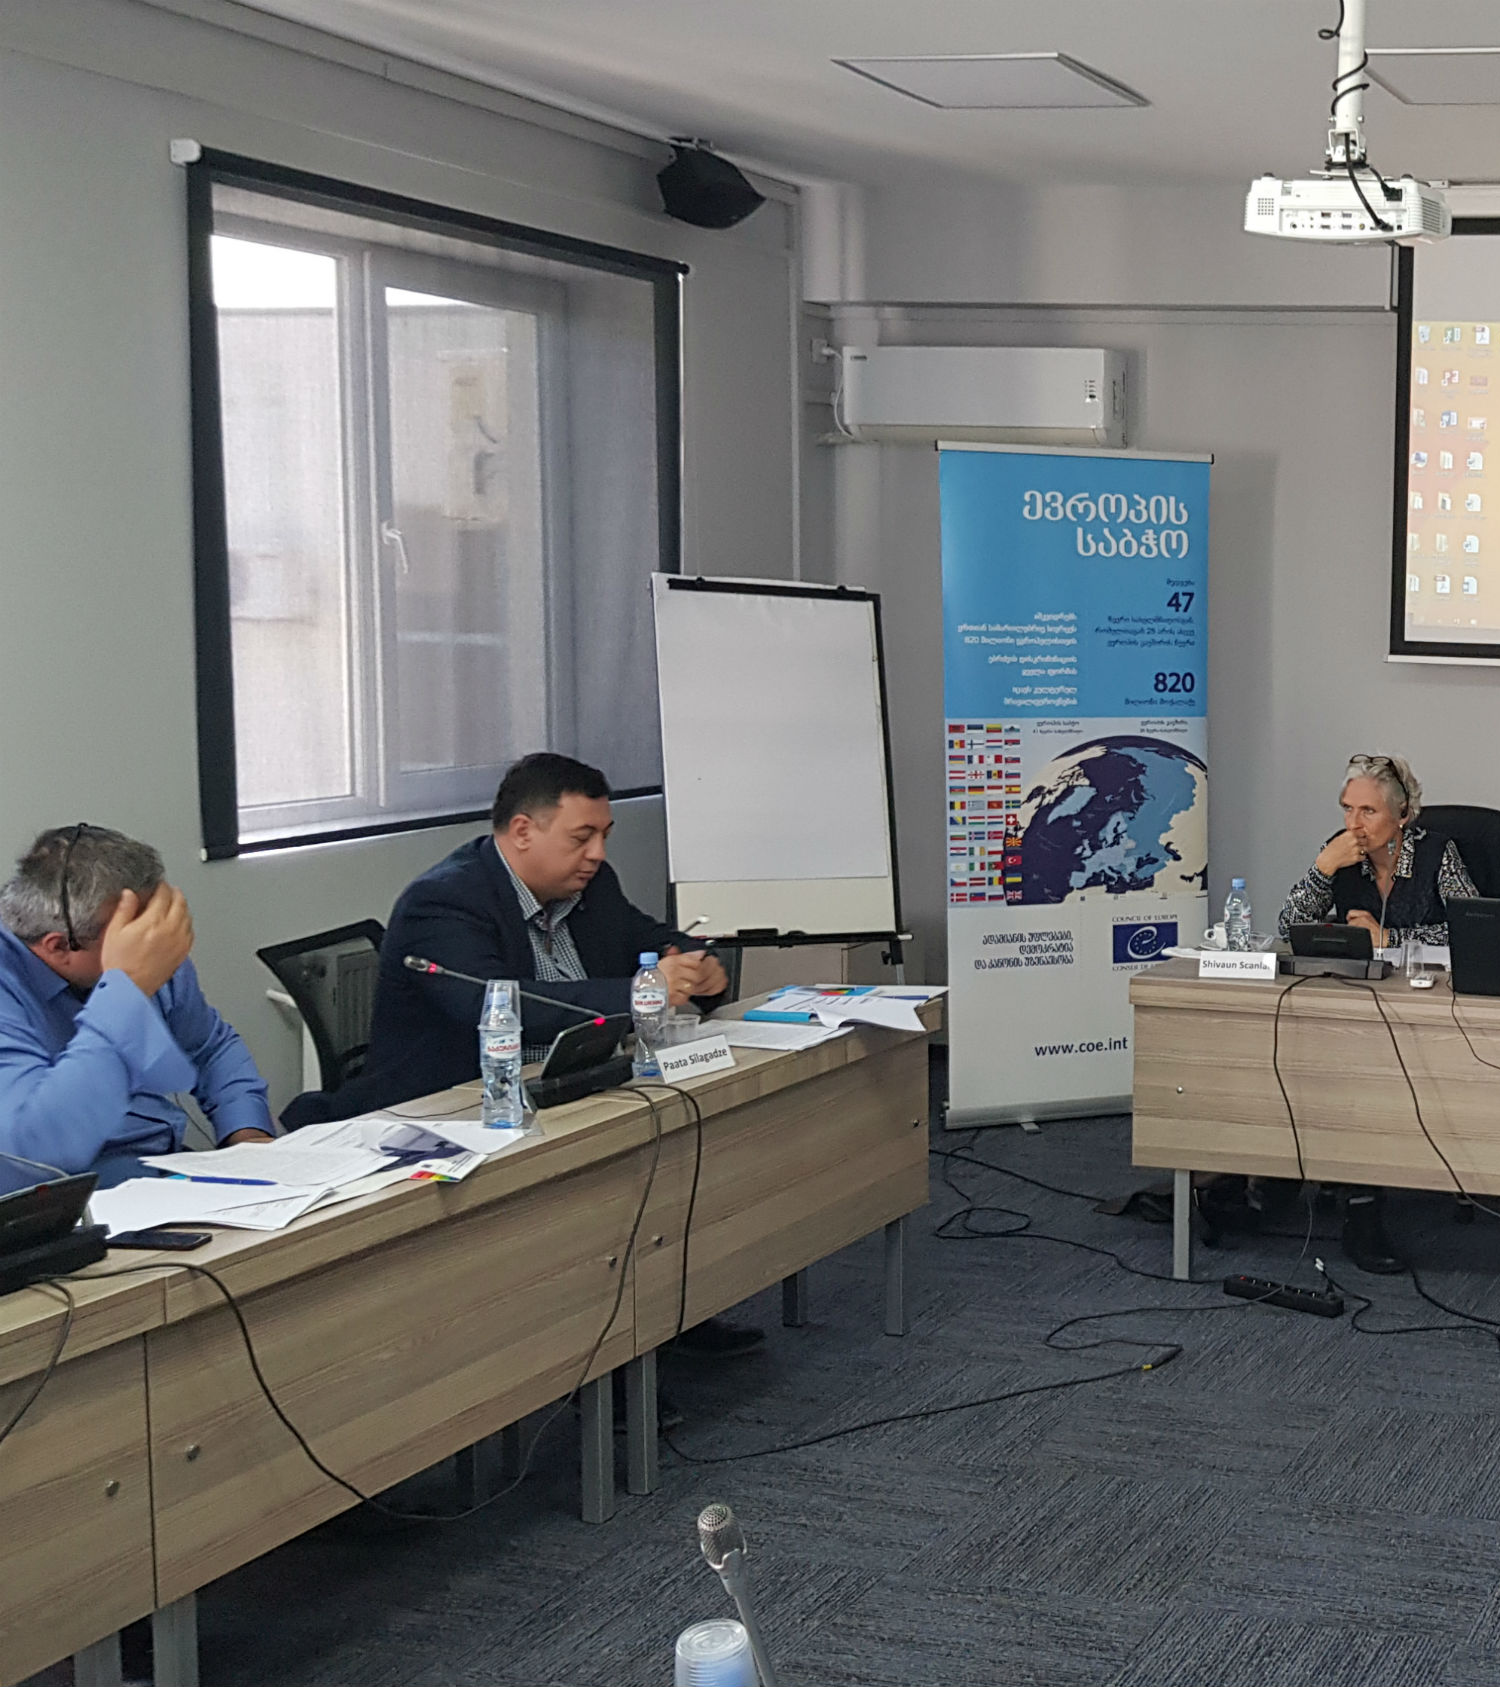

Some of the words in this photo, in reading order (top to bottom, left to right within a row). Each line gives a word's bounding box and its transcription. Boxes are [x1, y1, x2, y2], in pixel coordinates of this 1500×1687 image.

[1022, 489, 1189, 526] ევროპის
[1076, 527, 1189, 559] საბჭო
[1166, 591, 1195, 613] 47
[1153, 671, 1195, 693] 820
[1202, 960, 1238, 969] Shivaun
[1034, 1036, 1128, 1057] www.coe.int
[663, 1058, 689, 1072] Paata
[689, 1048, 728, 1064] Silagadze
